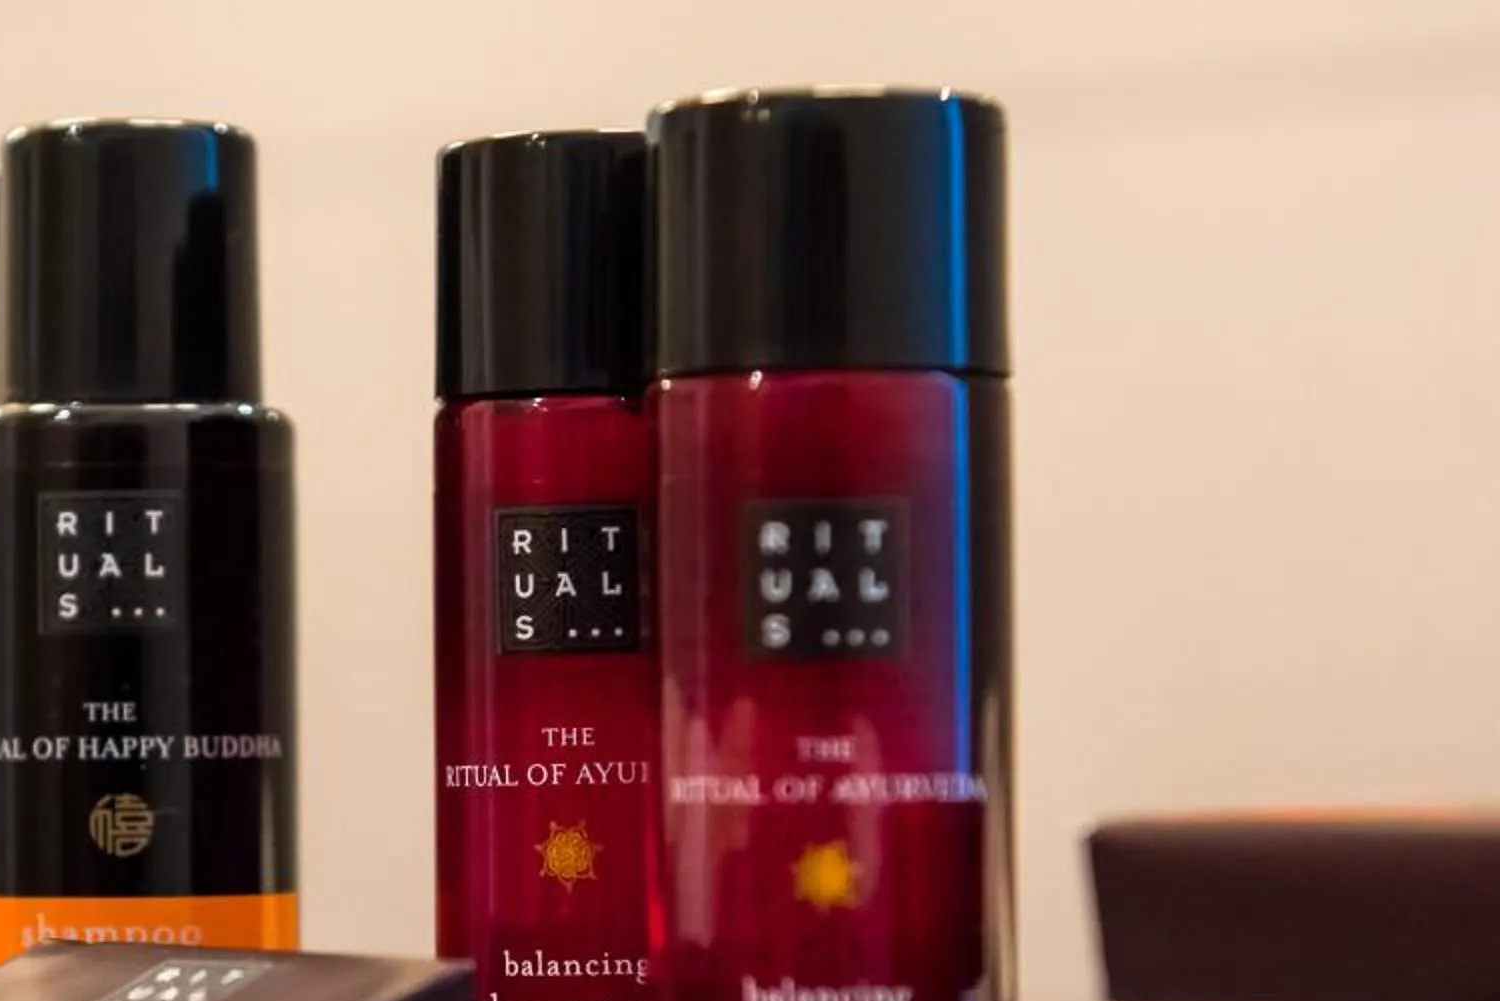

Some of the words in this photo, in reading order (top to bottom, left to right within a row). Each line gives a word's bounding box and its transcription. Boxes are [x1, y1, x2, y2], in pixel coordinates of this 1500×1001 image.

[83, 702, 137, 722] THE
[33, 737, 70, 760] OF
[78, 736, 175, 760] HAPPY
[183, 735, 282, 759] BUDDHA
[541, 727, 595, 747] THE
[797, 736, 856, 763] THE
[445, 764, 518, 788] RITUAL
[526, 762, 566, 786] OF
[772, 774, 824, 804] OF
[503, 950, 648, 985] balancing
